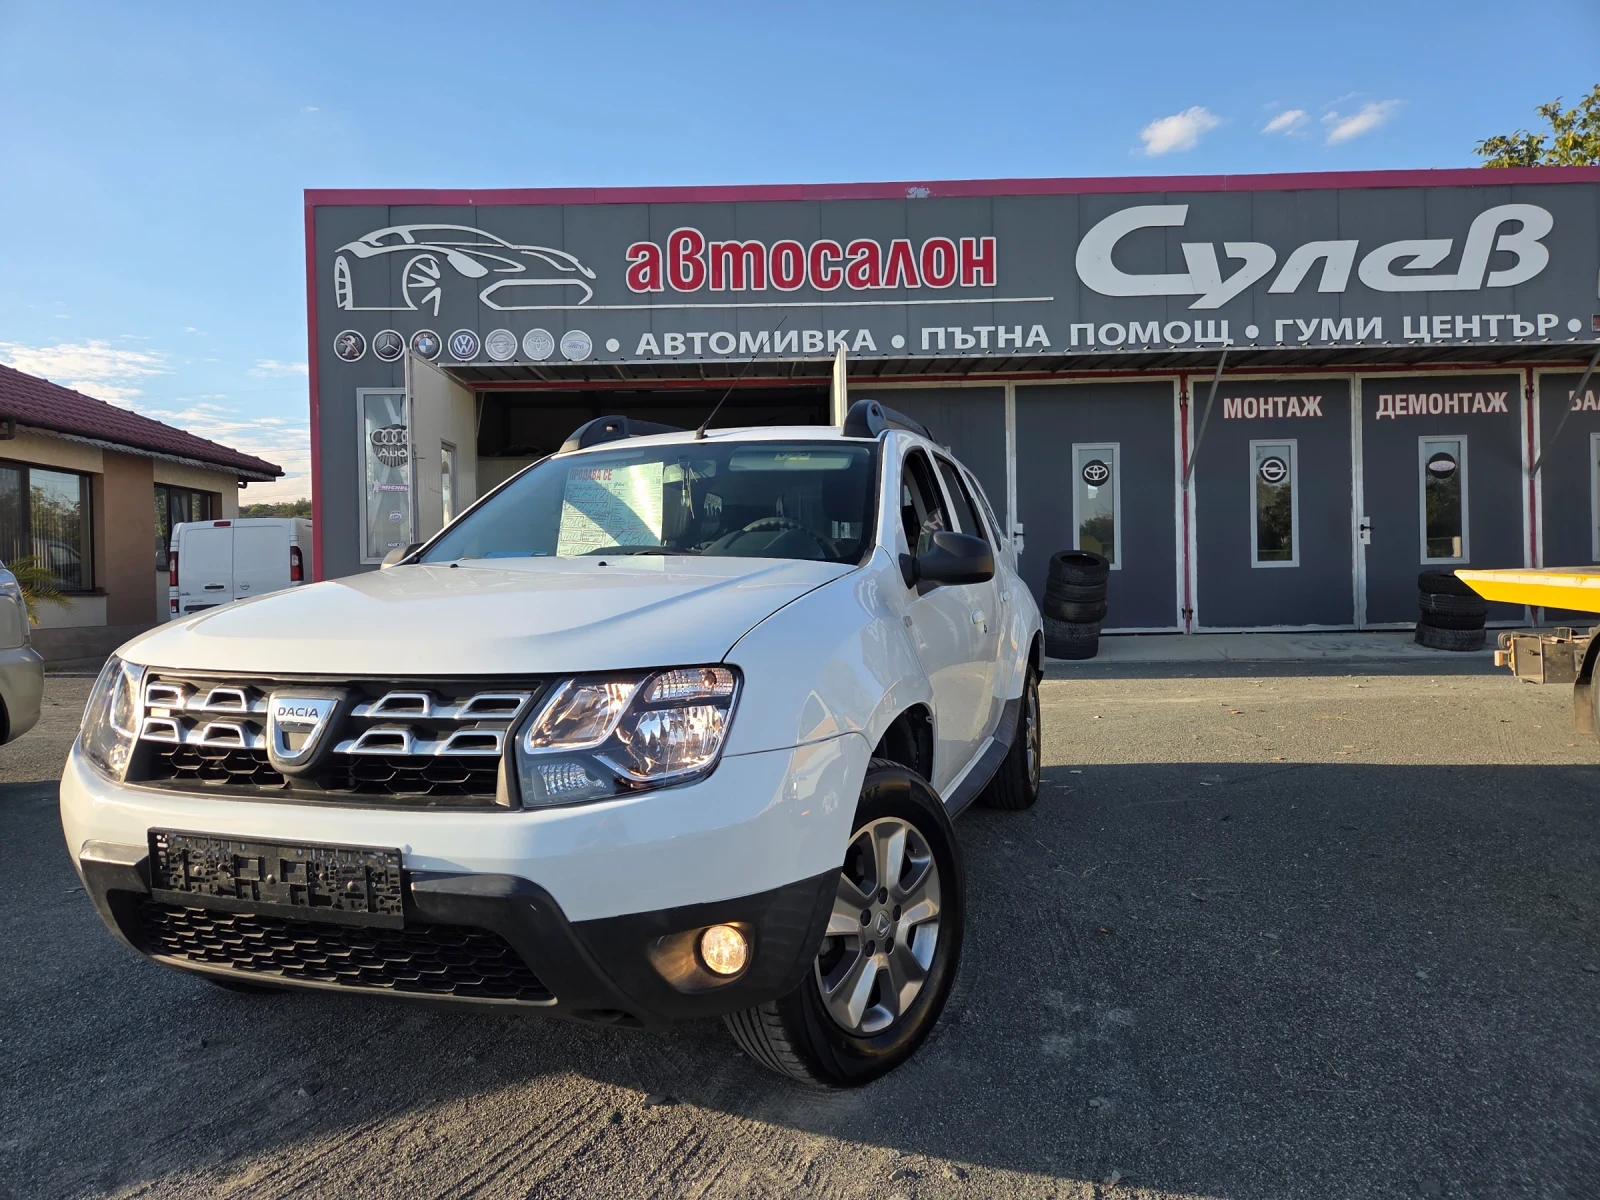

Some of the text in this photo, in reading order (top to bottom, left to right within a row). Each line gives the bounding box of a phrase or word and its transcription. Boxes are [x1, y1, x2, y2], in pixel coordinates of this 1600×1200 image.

[624, 226, 998, 295] автосалон
[1075, 203, 1555, 310] Сулев
[635, 312, 1559, 356] АВТОМИВКА ПЪТНА ПОМОЩ ГУМИ ЦЕНТЪР
[1222, 395, 1324, 420] МОНТАЖ
[1376, 391, 1509, 420] ДЕМОНТАЖ
[1568, 389, 1600, 411] БА
[378, 448, 408, 458] Aud
[603, 468, 613, 481] СЕ
[277, 706, 319, 718] DACIA
